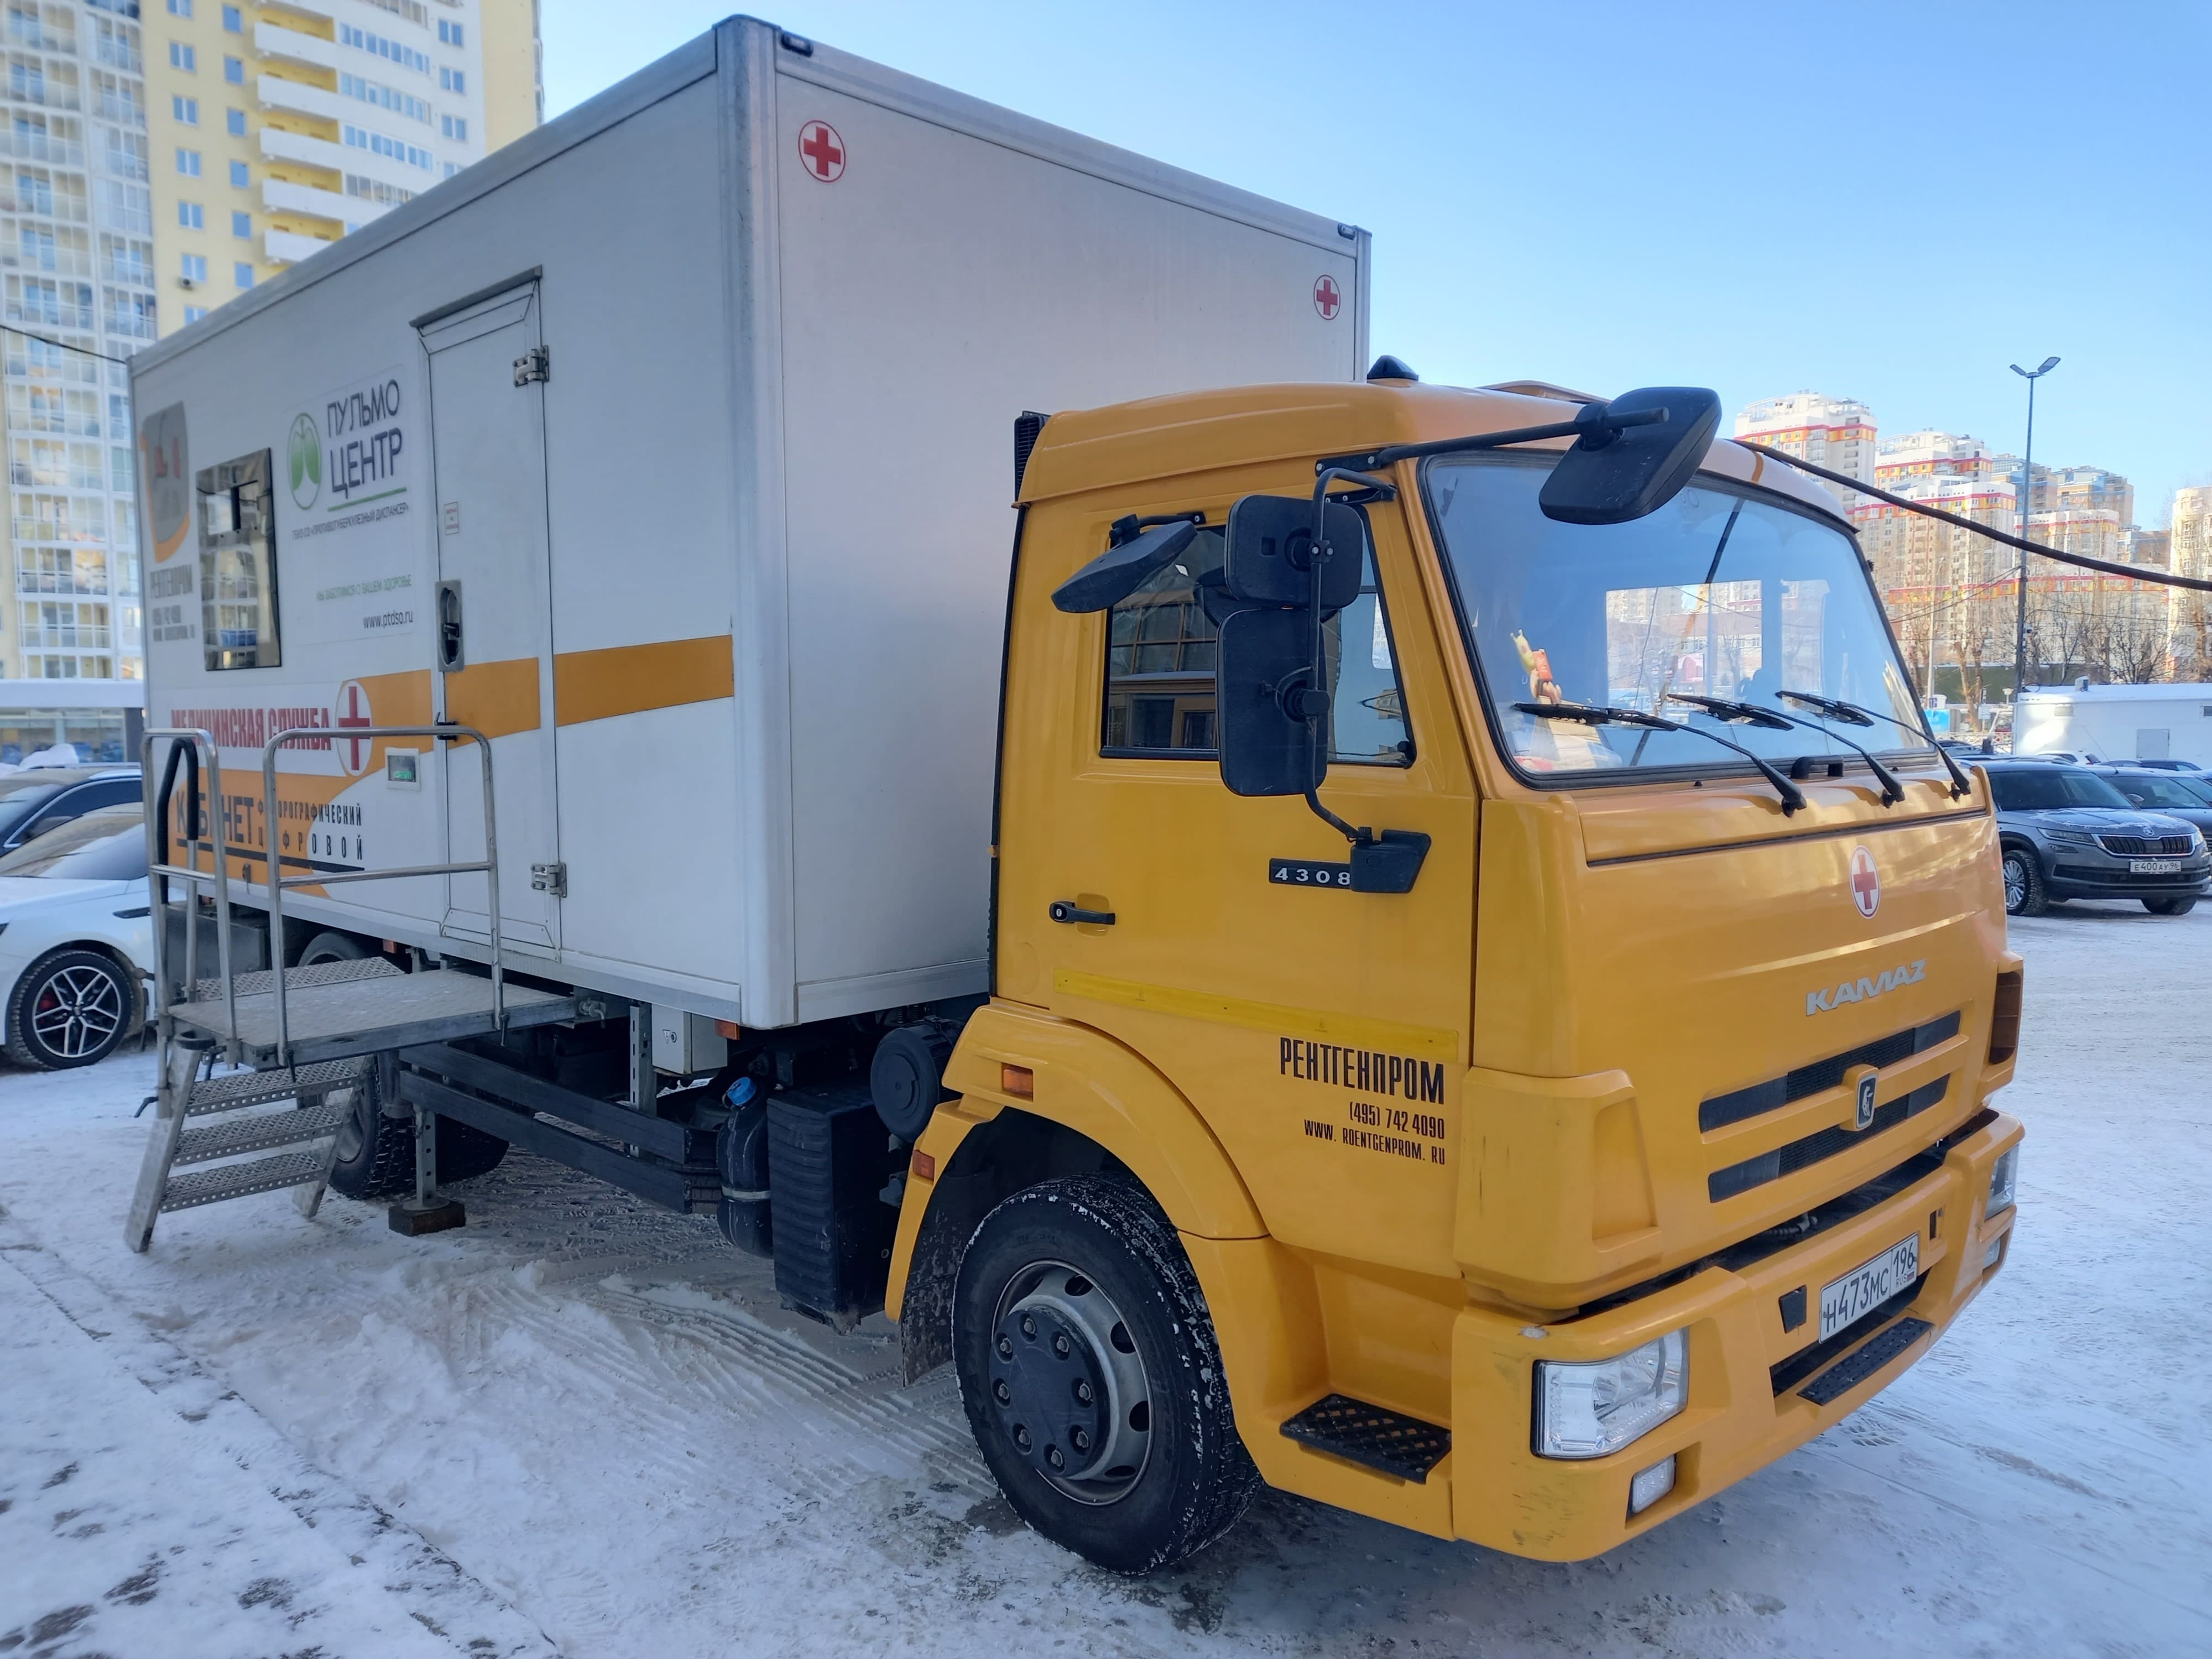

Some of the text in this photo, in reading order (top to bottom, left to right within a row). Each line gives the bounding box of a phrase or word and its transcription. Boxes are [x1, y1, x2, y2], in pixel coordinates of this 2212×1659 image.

[327, 379, 399, 438] ПУЛЬМО
[330, 427, 402, 499] ЦЕНТР
[363, 610, 413, 629] www.ptdso.ru
[268, 708, 331, 750] СЛУЖБА
[176, 790, 253, 844] КБНЕТ
[258, 799, 361, 826] ФОРОГРАФИЧЕСКИЙ
[258, 827, 362, 860] ЦФРОВОЙ
[1275, 868, 1350, 885] 4308
[1806, 958, 1926, 1016] KAMAZ
[1280, 1037, 1444, 1104] РЕНТГЕНПРОМ
[1349, 1102, 1444, 1139] (495) 742 4090
[1431, 1146, 1444, 1165] RU
[1827, 1243, 1914, 1333] Н473МС 196
[1896, 1274, 1907, 1288] RUS
